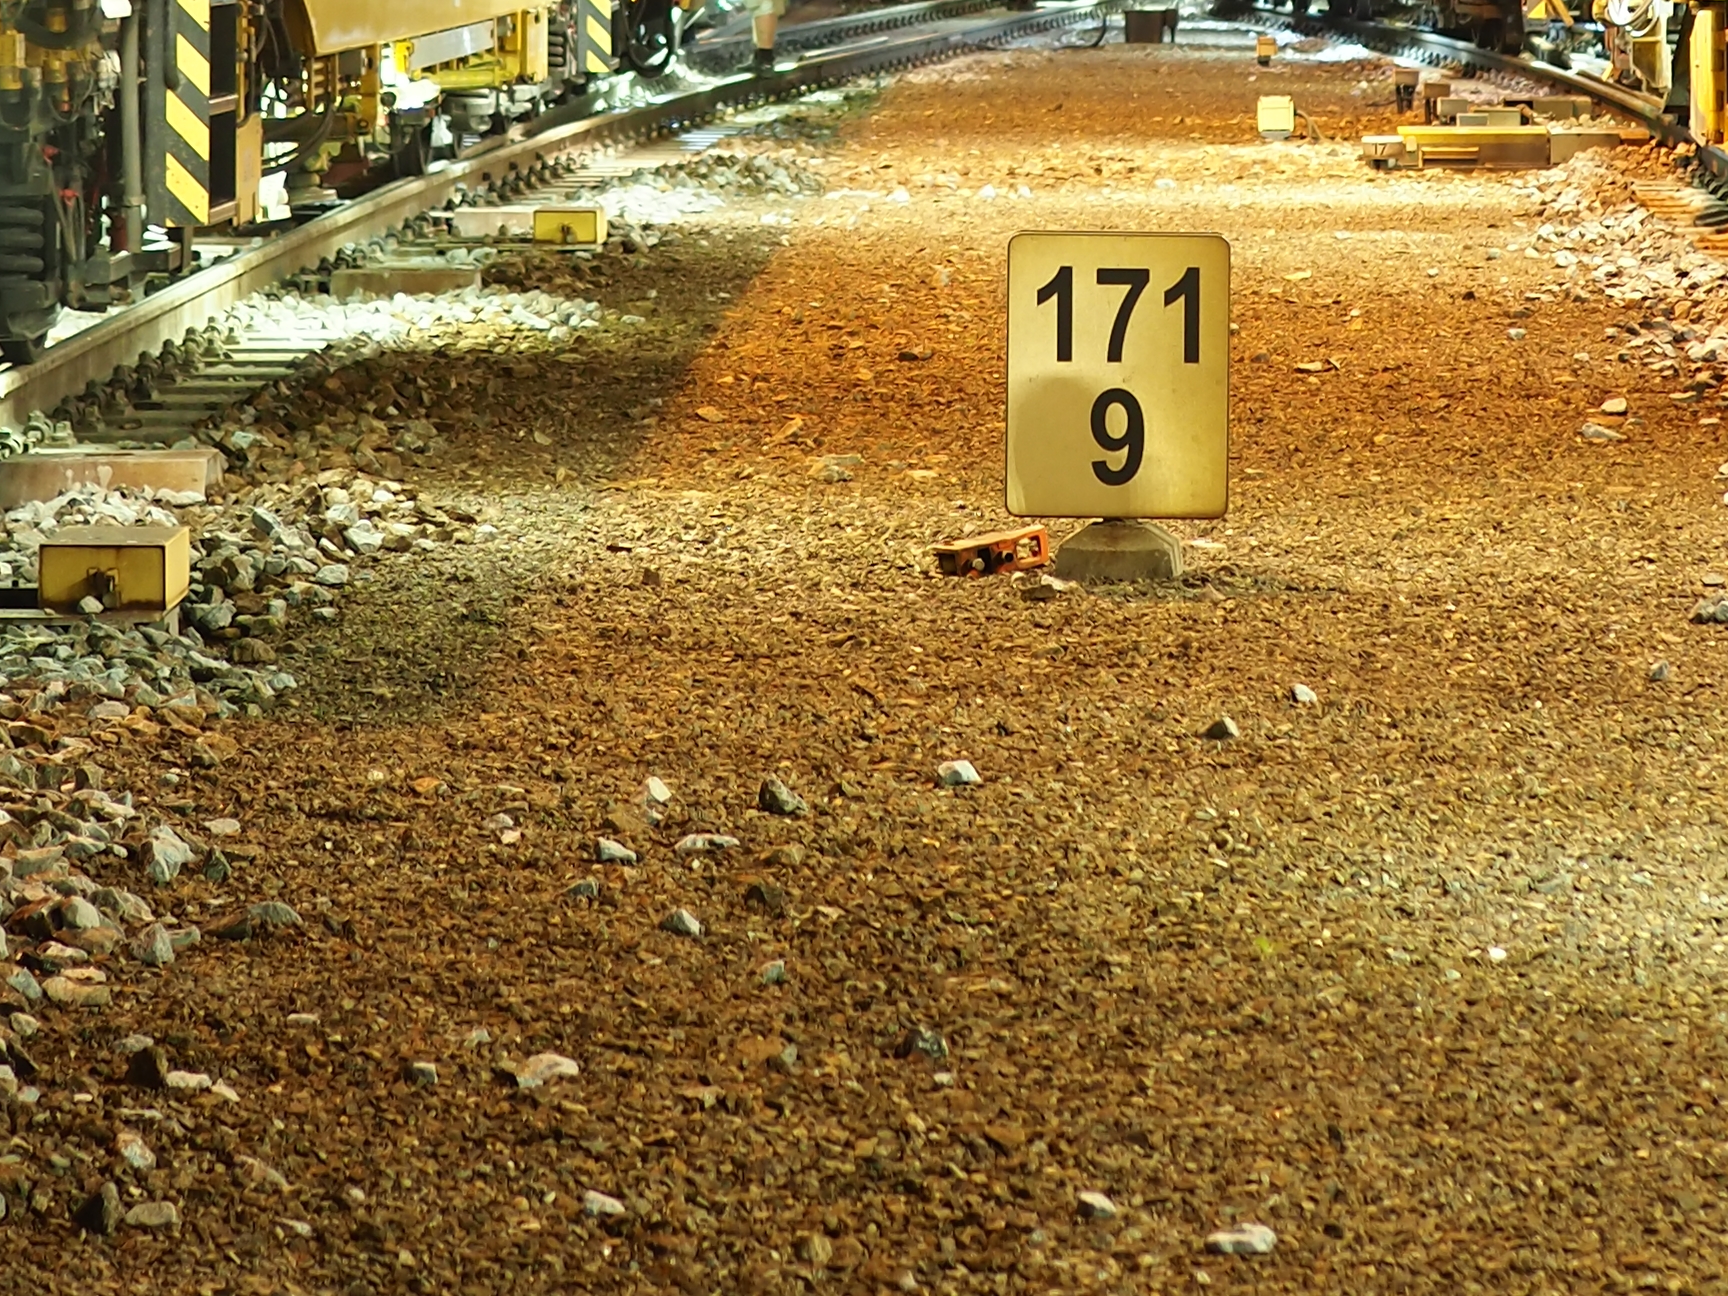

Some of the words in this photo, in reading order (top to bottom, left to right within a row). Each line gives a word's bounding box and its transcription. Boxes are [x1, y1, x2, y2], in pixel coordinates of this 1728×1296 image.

[1374, 142, 1387, 156] 17
[1035, 265, 1201, 364] 171
[1090, 387, 1145, 486] 9
